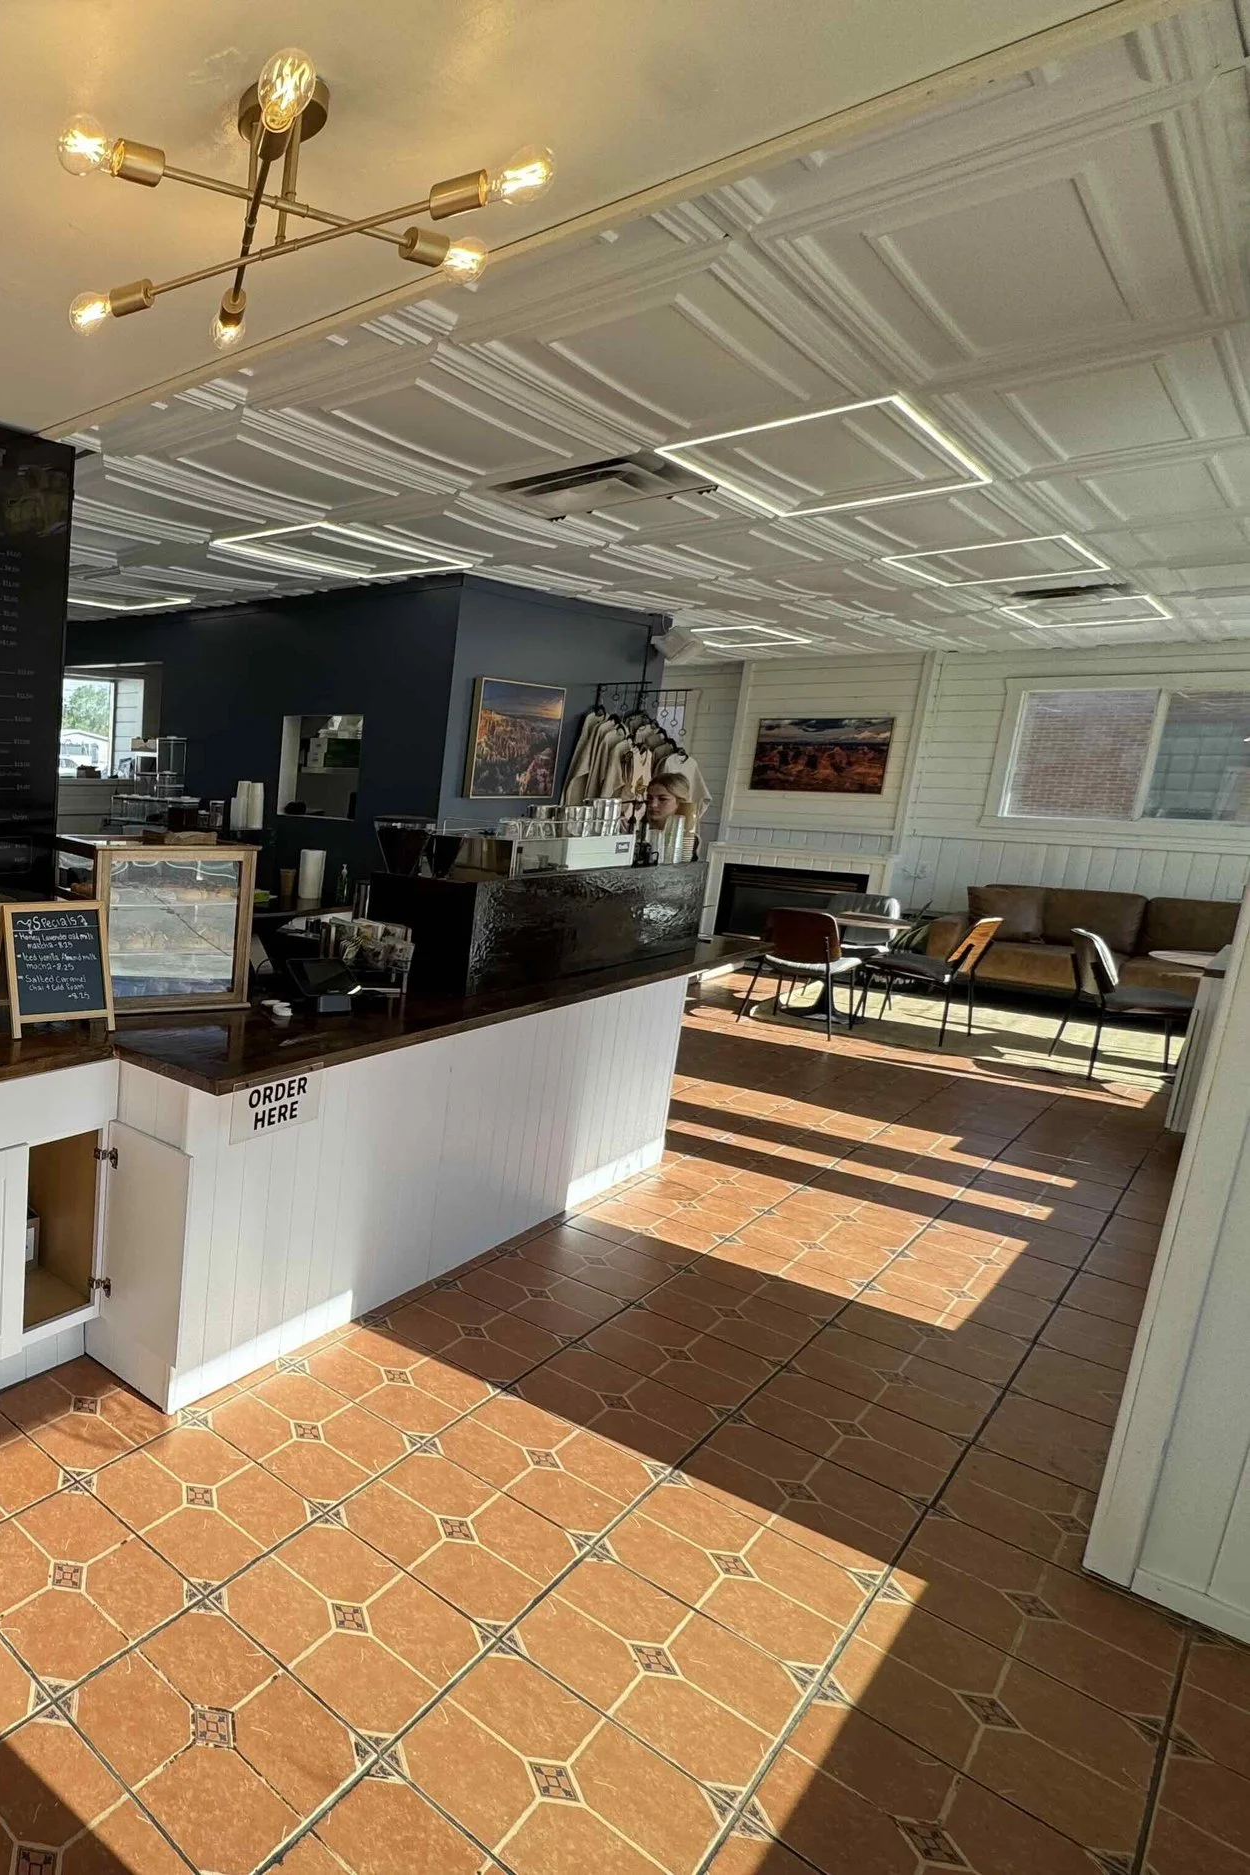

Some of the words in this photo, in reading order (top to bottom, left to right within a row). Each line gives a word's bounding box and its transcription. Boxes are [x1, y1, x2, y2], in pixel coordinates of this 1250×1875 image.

[33, 914, 76, 930] Specials
[249, 1077, 308, 1108] ORDER
[254, 1101, 298, 1130] HERE
